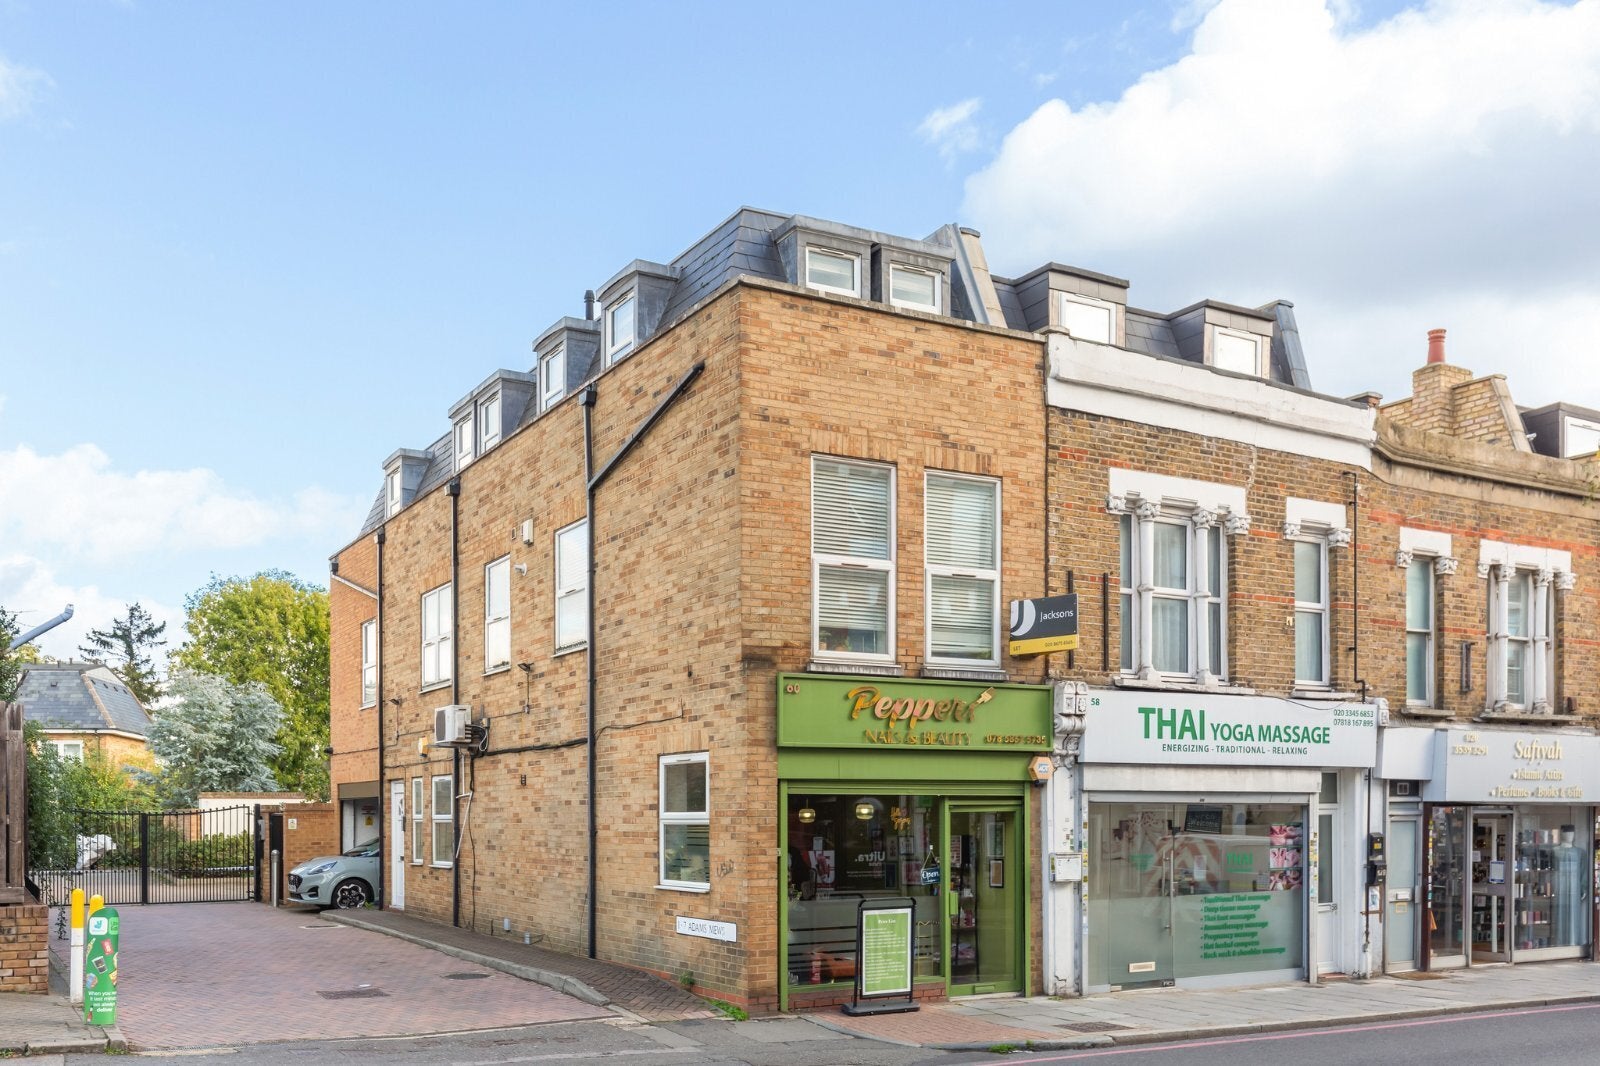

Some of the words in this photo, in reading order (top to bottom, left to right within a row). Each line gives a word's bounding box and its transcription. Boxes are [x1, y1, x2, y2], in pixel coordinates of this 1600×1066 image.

[1040, 610, 1074, 622] Jacksons
[1090, 698, 1100, 706] 58
[1333, 709, 1345, 717] 020
[1138, 706, 1205, 741] THAI
[1210, 722, 1255, 742] YOGA
[1258, 724, 1330, 744] MASSAGE
[922, 730, 972, 746] BEAUTY
[1162, 743, 1209, 753] ENERGIZING
[1215, 745, 1266, 754] TRADITIONAL
[1272, 746, 1308, 755] RELAXING
[1514, 737, 1563, 766] Safiyah
[921, 870, 939, 881] Open
[688, 922, 707, 934] ADAMS
